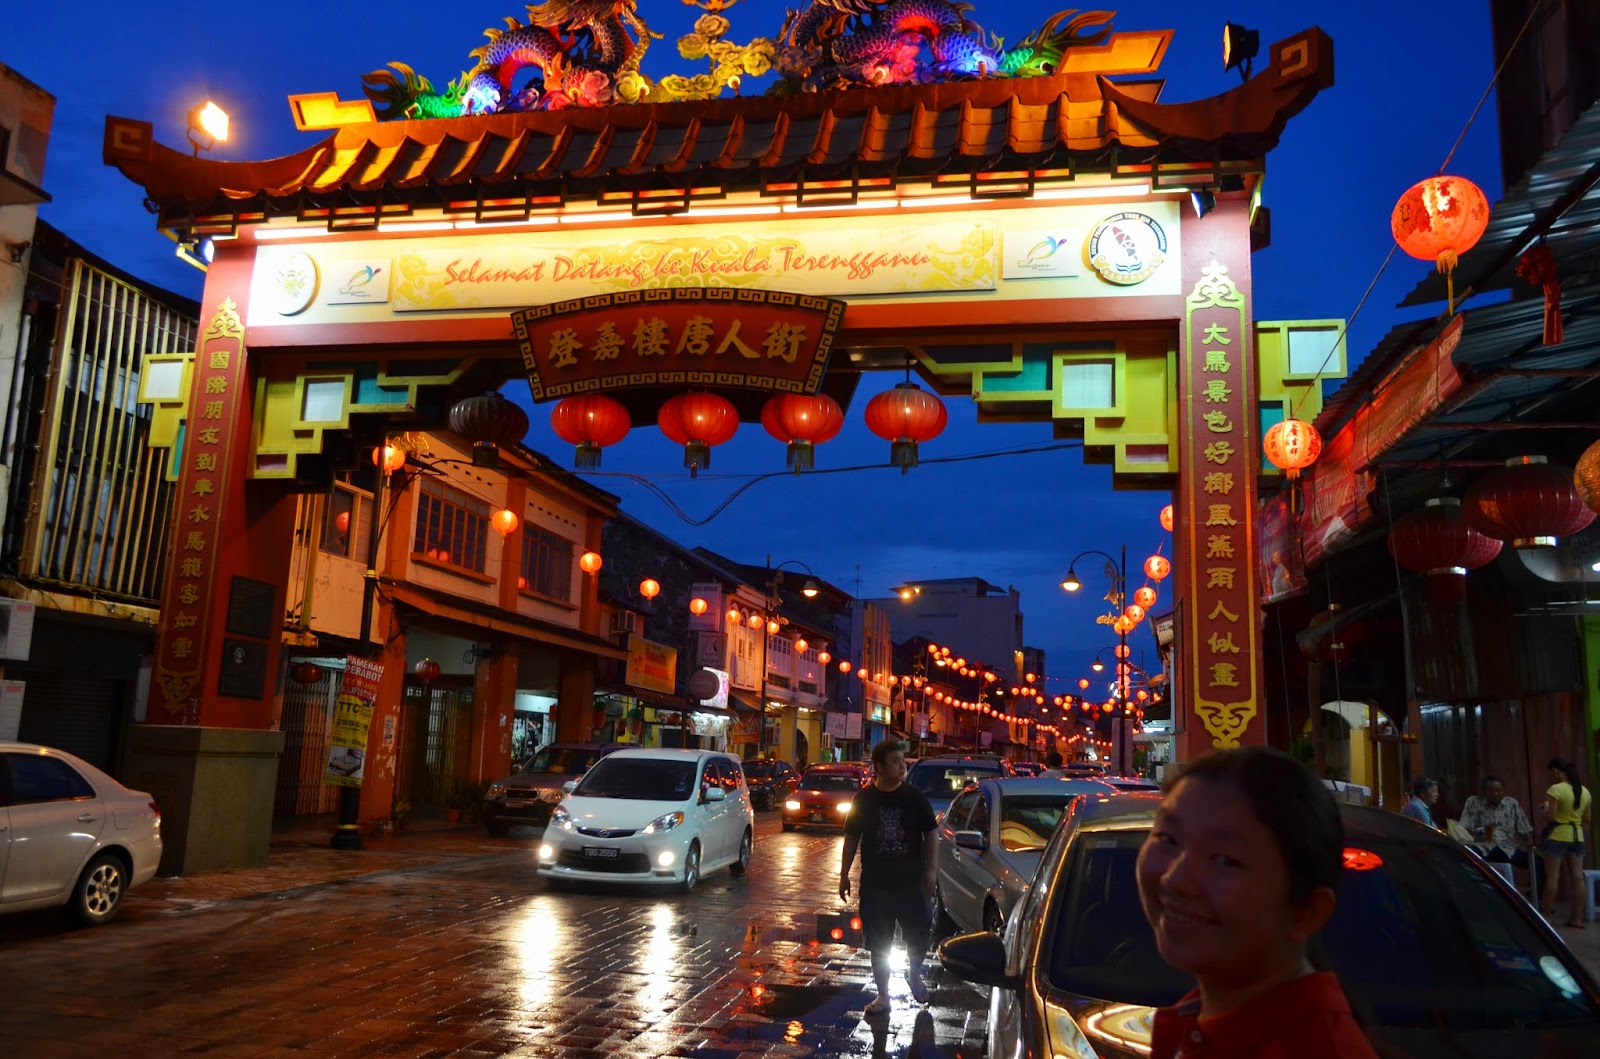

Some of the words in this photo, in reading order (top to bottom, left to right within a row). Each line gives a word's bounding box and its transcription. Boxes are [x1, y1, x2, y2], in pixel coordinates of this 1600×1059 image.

[443, 260, 545, 286] Selamat
[552, 256, 644, 287] Datang
[654, 252, 680, 278] ke
[691, 247, 769, 274] Kuala
[779, 246, 930, 280] Terengganu
[548, 316, 806, 369] 登嘉樓唐人街
[344, 664, 382, 682] PERABOT
[346, 655, 385, 674] PAMERAN
[347, 686, 378, 700] LIFESTYLE
[340, 701, 359, 714] TTC
